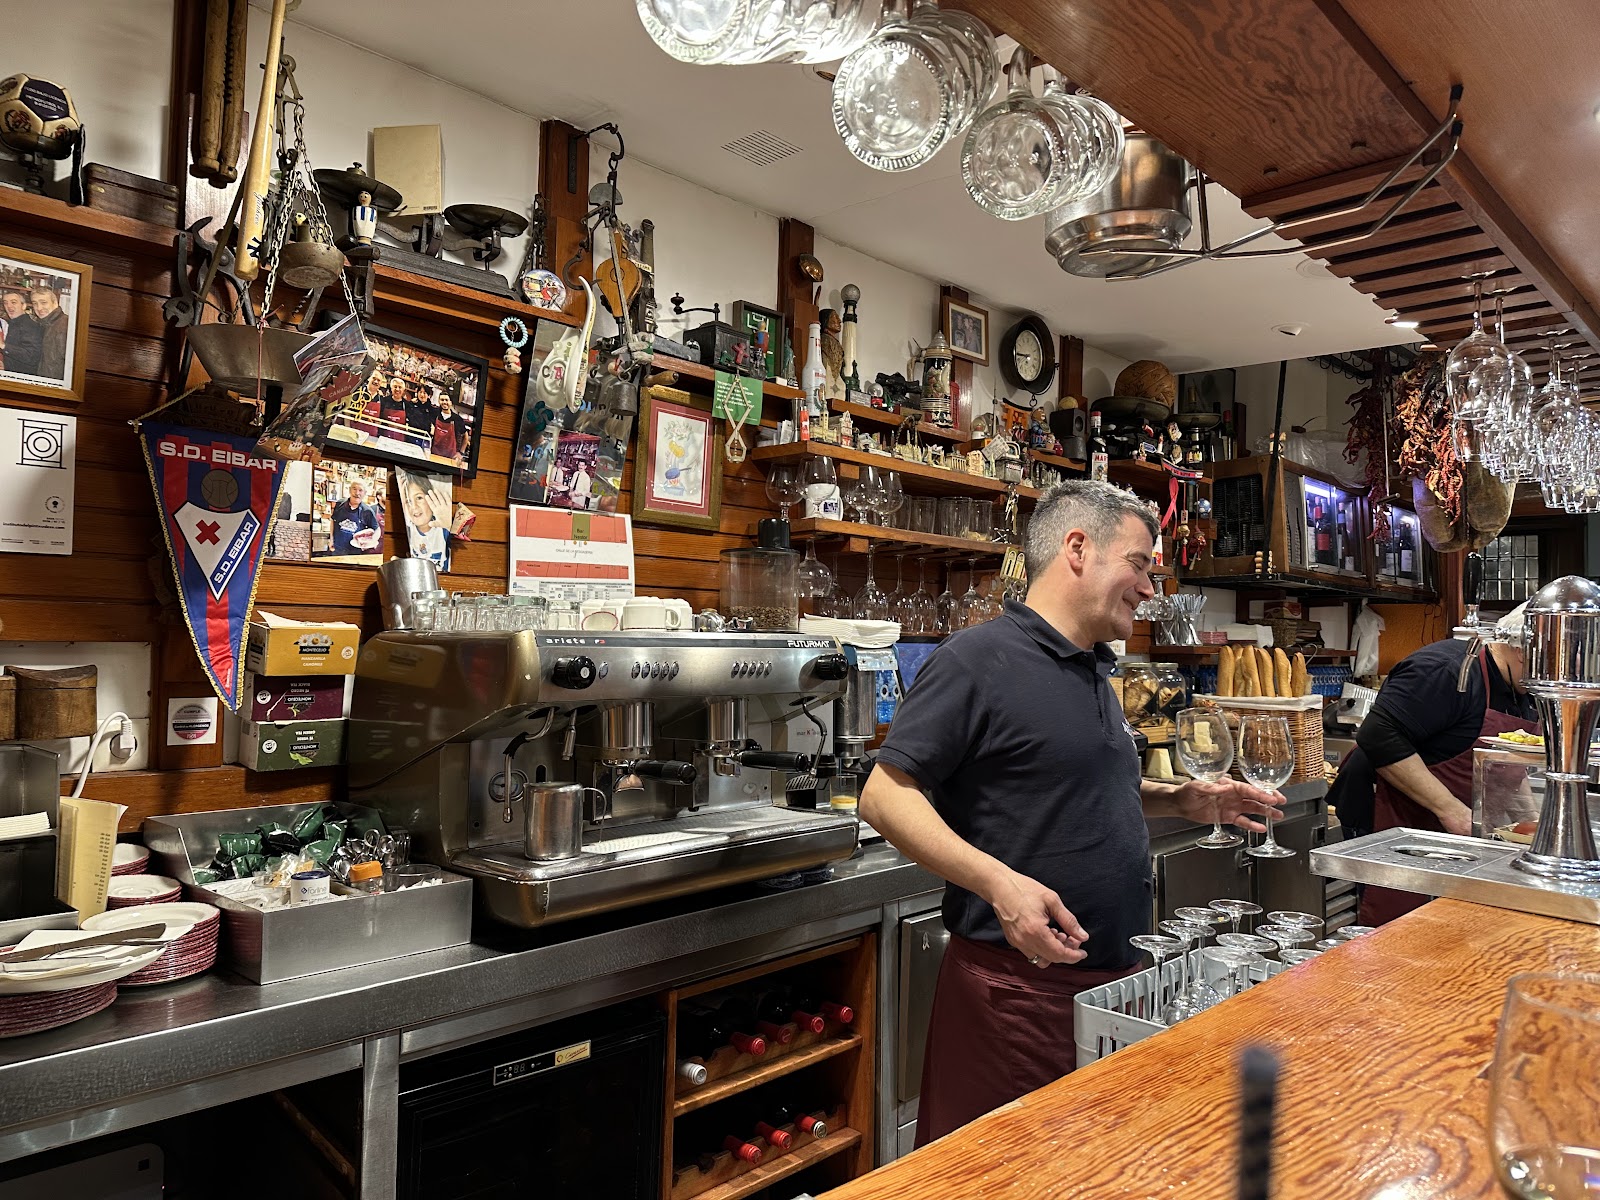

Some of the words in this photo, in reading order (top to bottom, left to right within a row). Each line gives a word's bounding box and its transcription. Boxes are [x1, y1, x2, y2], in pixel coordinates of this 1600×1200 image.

[328, 385, 352, 398] CANADA
[160, 441, 207, 461] S.D.
[212, 449, 277, 472] EIBAR
[213, 560, 234, 584] S.D.
[228, 521, 254, 560] EIBAR
[787, 640, 830, 648] FUTURMAT
